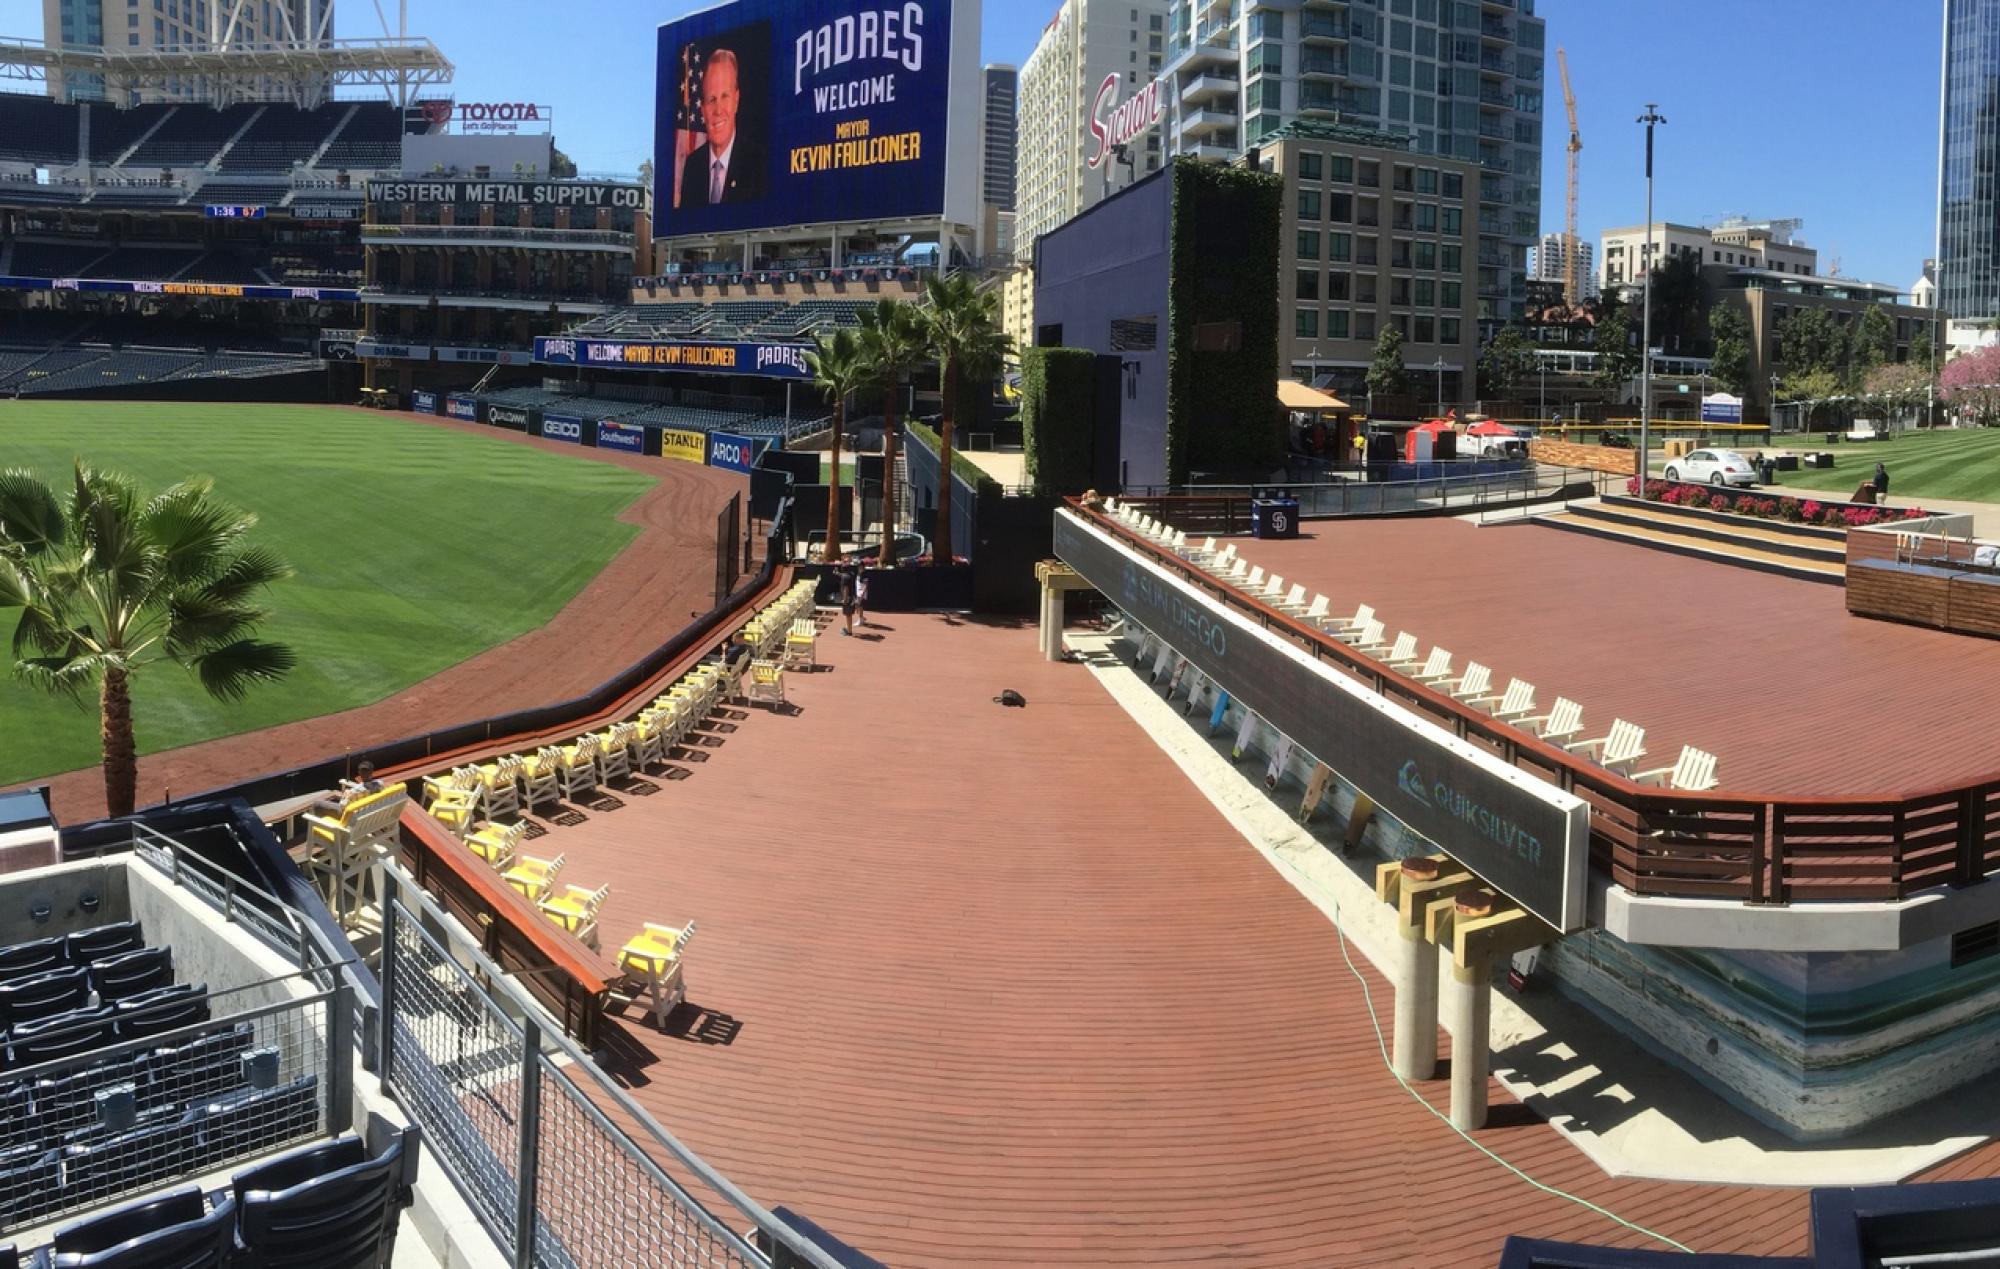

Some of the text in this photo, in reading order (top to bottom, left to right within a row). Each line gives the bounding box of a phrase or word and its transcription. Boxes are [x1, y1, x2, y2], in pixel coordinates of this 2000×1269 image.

[795, 2, 923, 95] PADRES
[814, 74, 895, 113] WELCOME
[458, 103, 539, 120] TOYOTA
[836, 119, 870, 139] MAYOR
[1088, 72, 1163, 176] Sycuan
[790, 131, 921, 174] KEVIN FAULCONER
[369, 183, 643, 208] WESTERN METAL SUPPLY CO.
[543, 339, 577, 361] PADRES
[587, 344, 736, 367] WELCOME MAYOR KEVIN FAULCONER
[757, 346, 808, 375] PADRES
[489, 407, 526, 425] QUALCOMM
[544, 419, 580, 438] GEICO
[600, 430, 635, 445] Southwest
[664, 432, 704, 450] STANLEY
[711, 441, 740, 464] ARCO
[1172, 597, 1226, 657] DIEGO
[1433, 781, 1542, 867] QUIKSILVER
